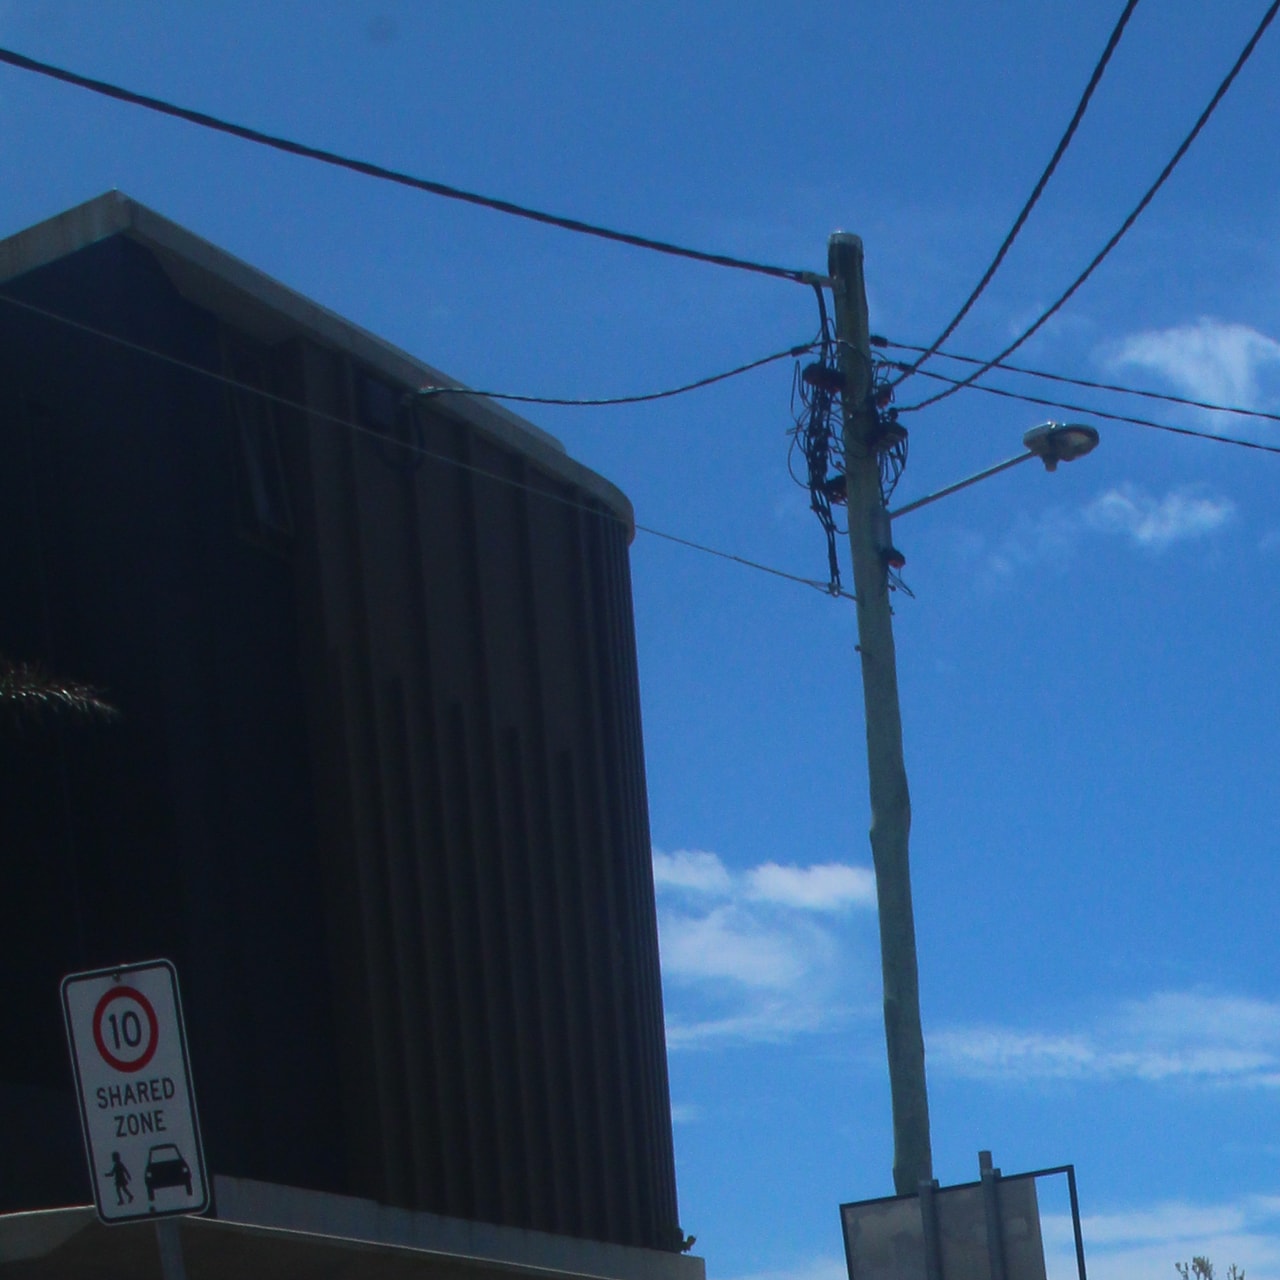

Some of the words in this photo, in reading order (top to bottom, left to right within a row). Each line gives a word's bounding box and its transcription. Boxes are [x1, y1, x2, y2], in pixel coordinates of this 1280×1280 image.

[108, 1010, 142, 1050] 10
[96, 1077, 176, 1109] SHARED
[114, 1110, 166, 1138] ZONE
